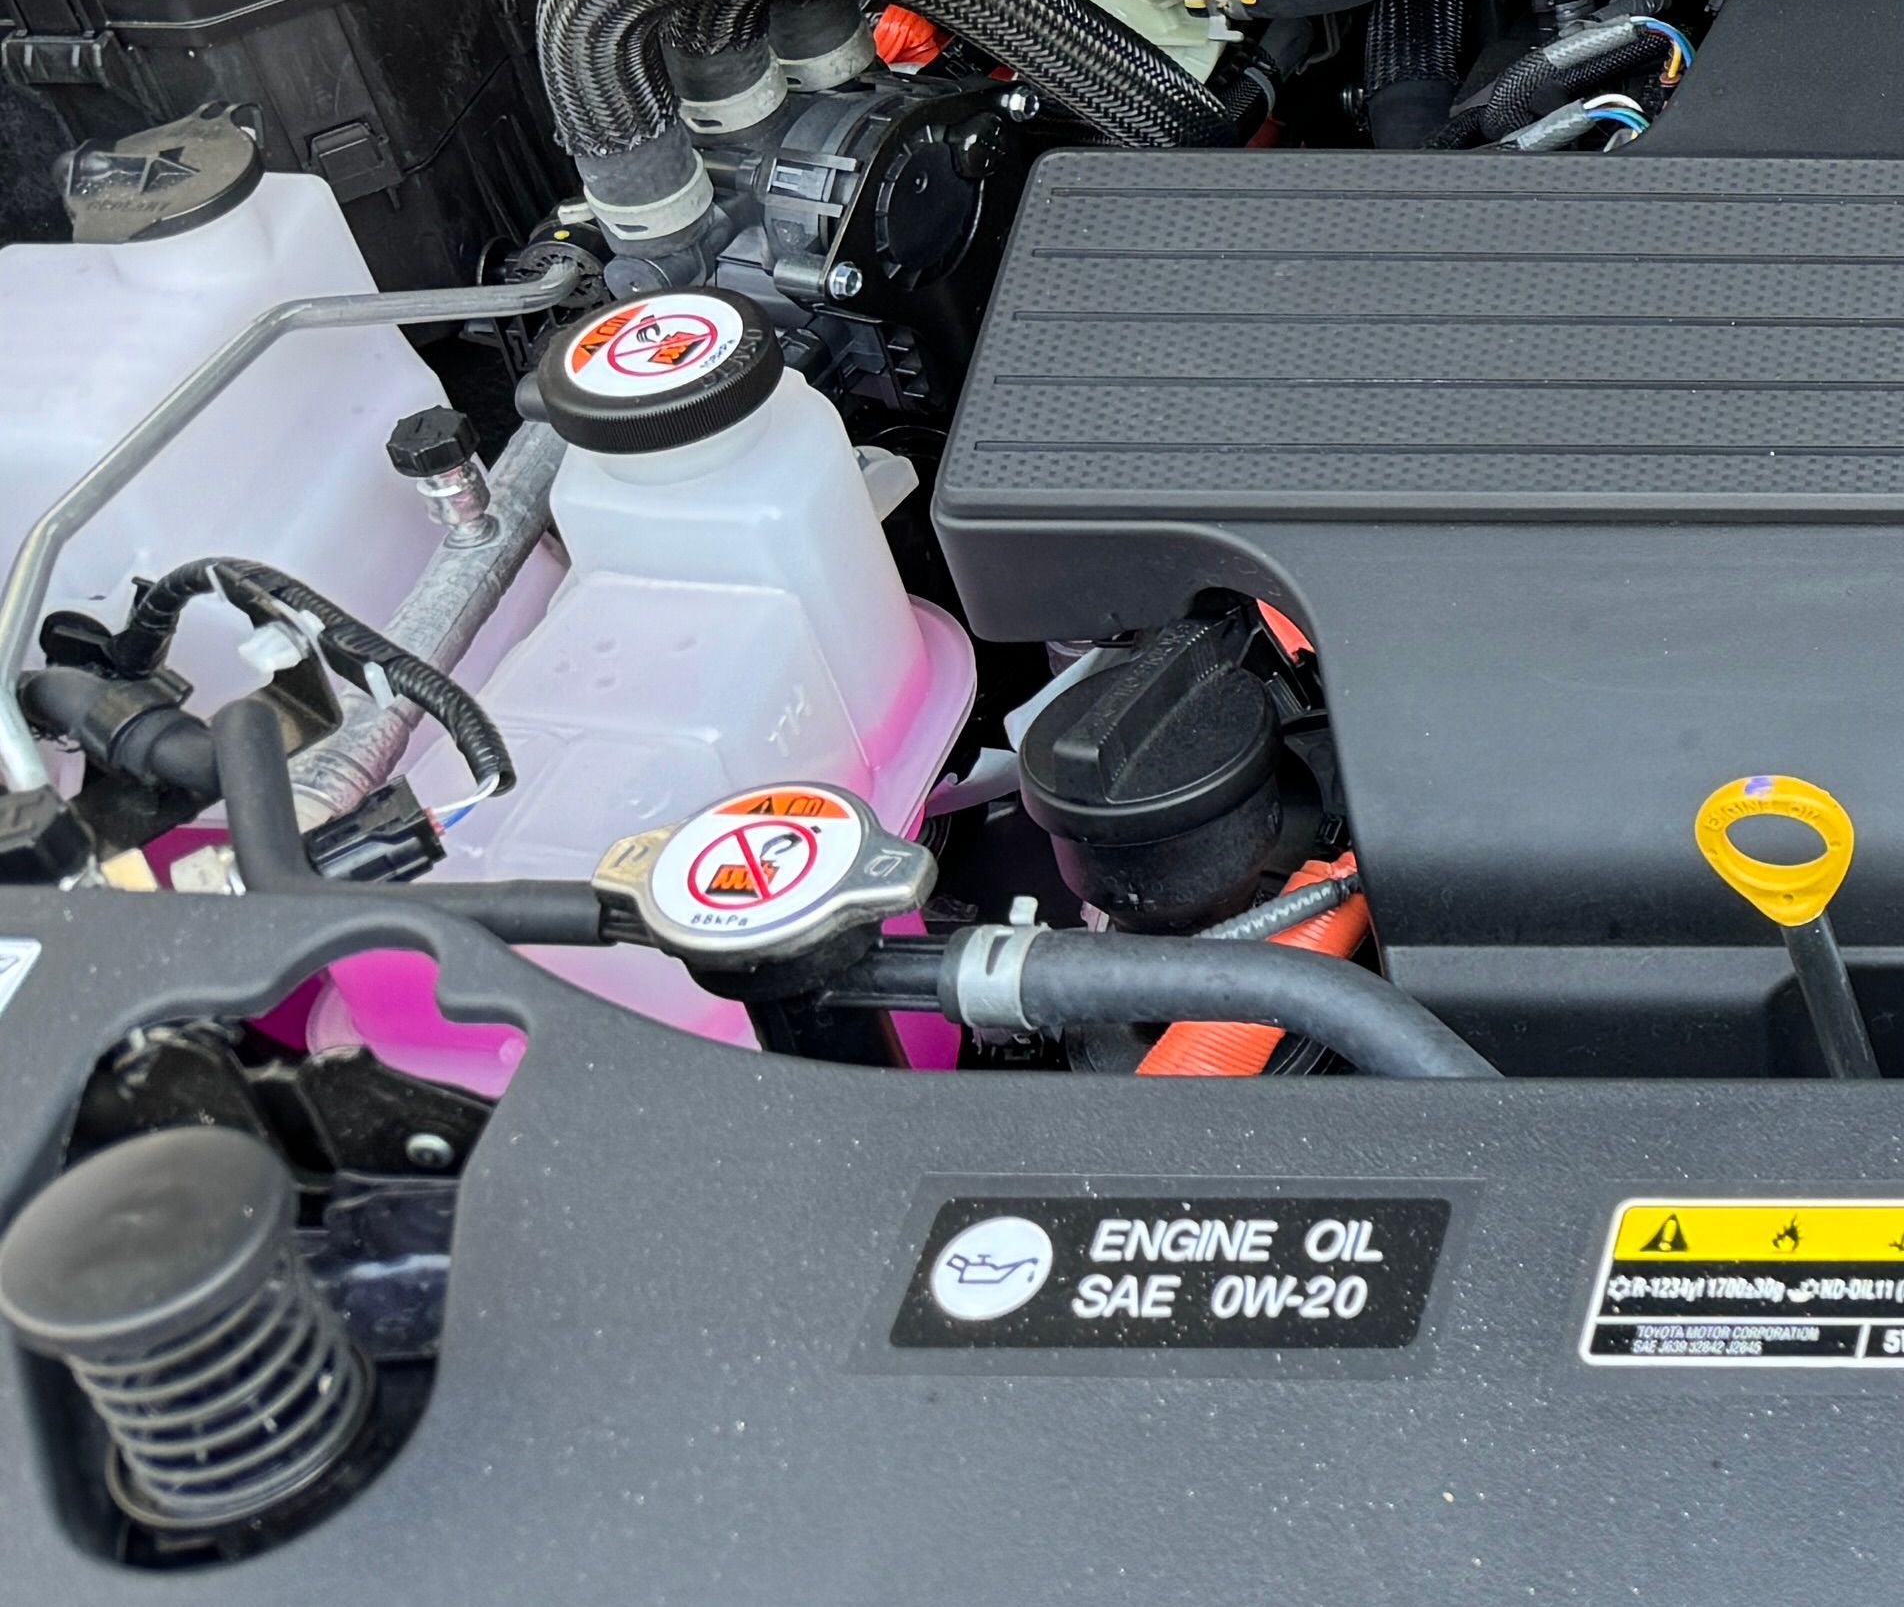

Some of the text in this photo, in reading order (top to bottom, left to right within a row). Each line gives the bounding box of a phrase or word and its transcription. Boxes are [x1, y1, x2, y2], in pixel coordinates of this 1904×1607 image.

[1090, 1219, 1384, 1262] ENGINE OIL
[1072, 1274, 1368, 1319] SAE 0W-20
[1632, 1340, 1656, 1354] SAE
[1636, 1325, 1820, 1341] TOYOTA MOTOR CORPORATION
